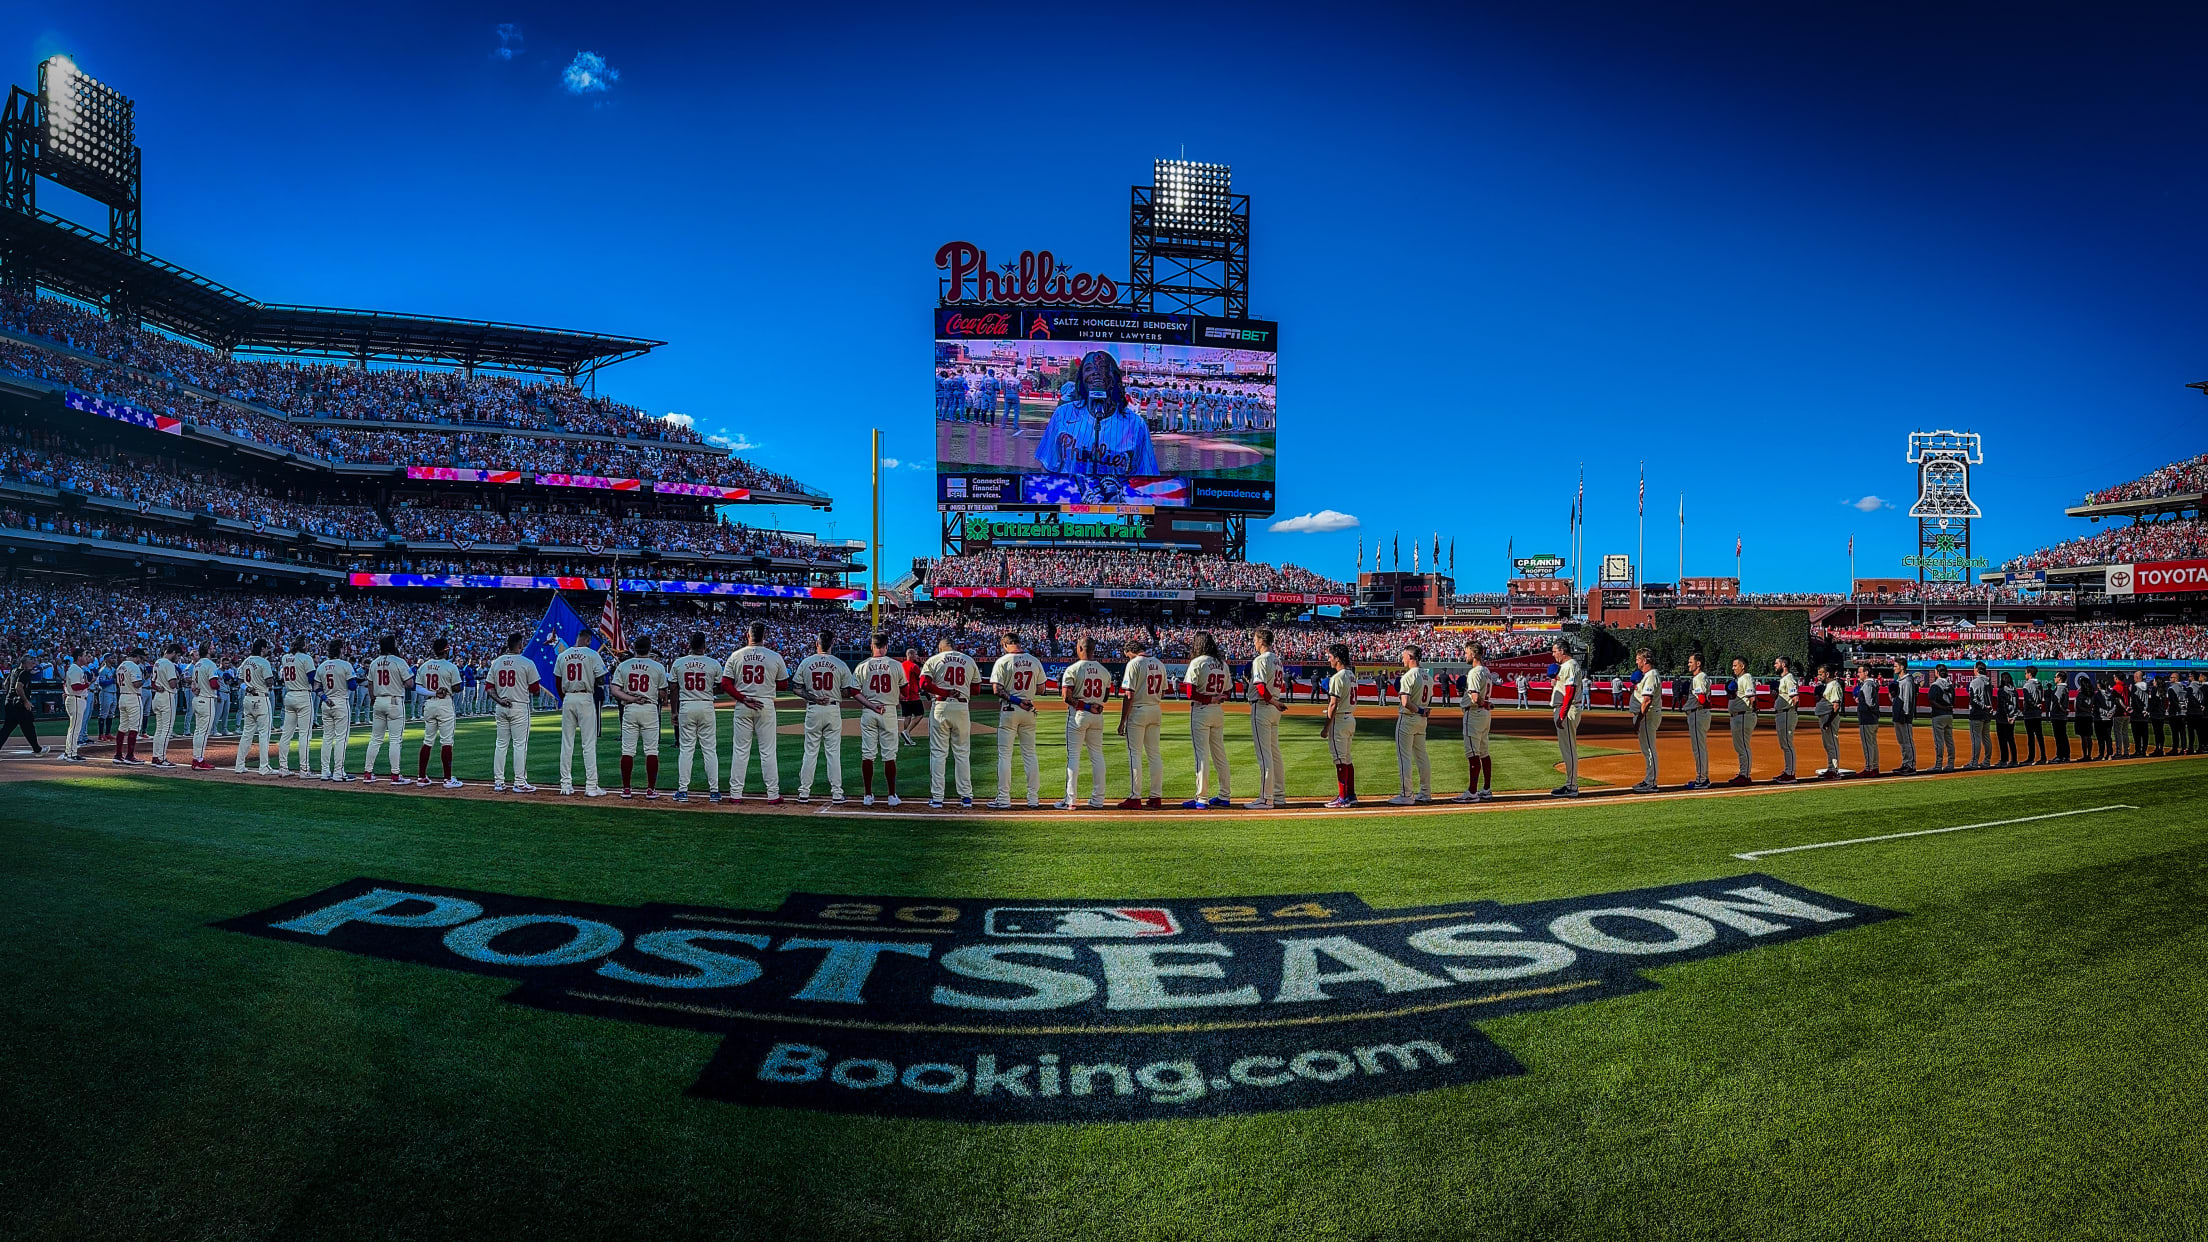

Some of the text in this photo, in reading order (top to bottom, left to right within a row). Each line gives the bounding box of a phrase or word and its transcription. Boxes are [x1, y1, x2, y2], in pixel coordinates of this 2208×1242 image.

[935, 241, 1118, 304] Phillies
[1053, 317, 1188, 331] SALTZ MONGELUZZI BENDESKY
[1079, 330, 1162, 341] INJURY LAWYERS
[971, 477, 1010, 486] Connecting
[1196, 487, 1261, 499] Independence
[992, 522, 1147, 539] Citizens Bank Park
[1904, 555, 1987, 568] Citizens Bank
[1932, 569, 1958, 581] Park
[2138, 567, 2208, 586] TOYOTA
[1110, 590, 1180, 599] LISCIO'S BAKERY
[1403, 584, 1430, 593] GIANT
[1270, 594, 1302, 602] TOYOTA
[1318, 596, 1348, 604] TOYOTA
[245, 668, 252, 682] 8
[283, 665, 297, 681] 28
[631, 664, 649, 672] BANKS
[742, 665, 765, 685] 53
[326, 673, 334, 689] 5
[425, 673, 439, 690] 18
[628, 673, 650, 692] 58
[683, 672, 706, 691] 55
[811, 671, 834, 691] 50
[1013, 670, 1033, 691] 37
[1083, 678, 1103, 698] 33
[1147, 674, 1163, 695] 27
[1206, 673, 1225, 694] 25
[817, 901, 1339, 926] 20 24
[268, 883, 1856, 1012] POSTSEASON
[756, 1038, 1457, 1103] Booking.com
